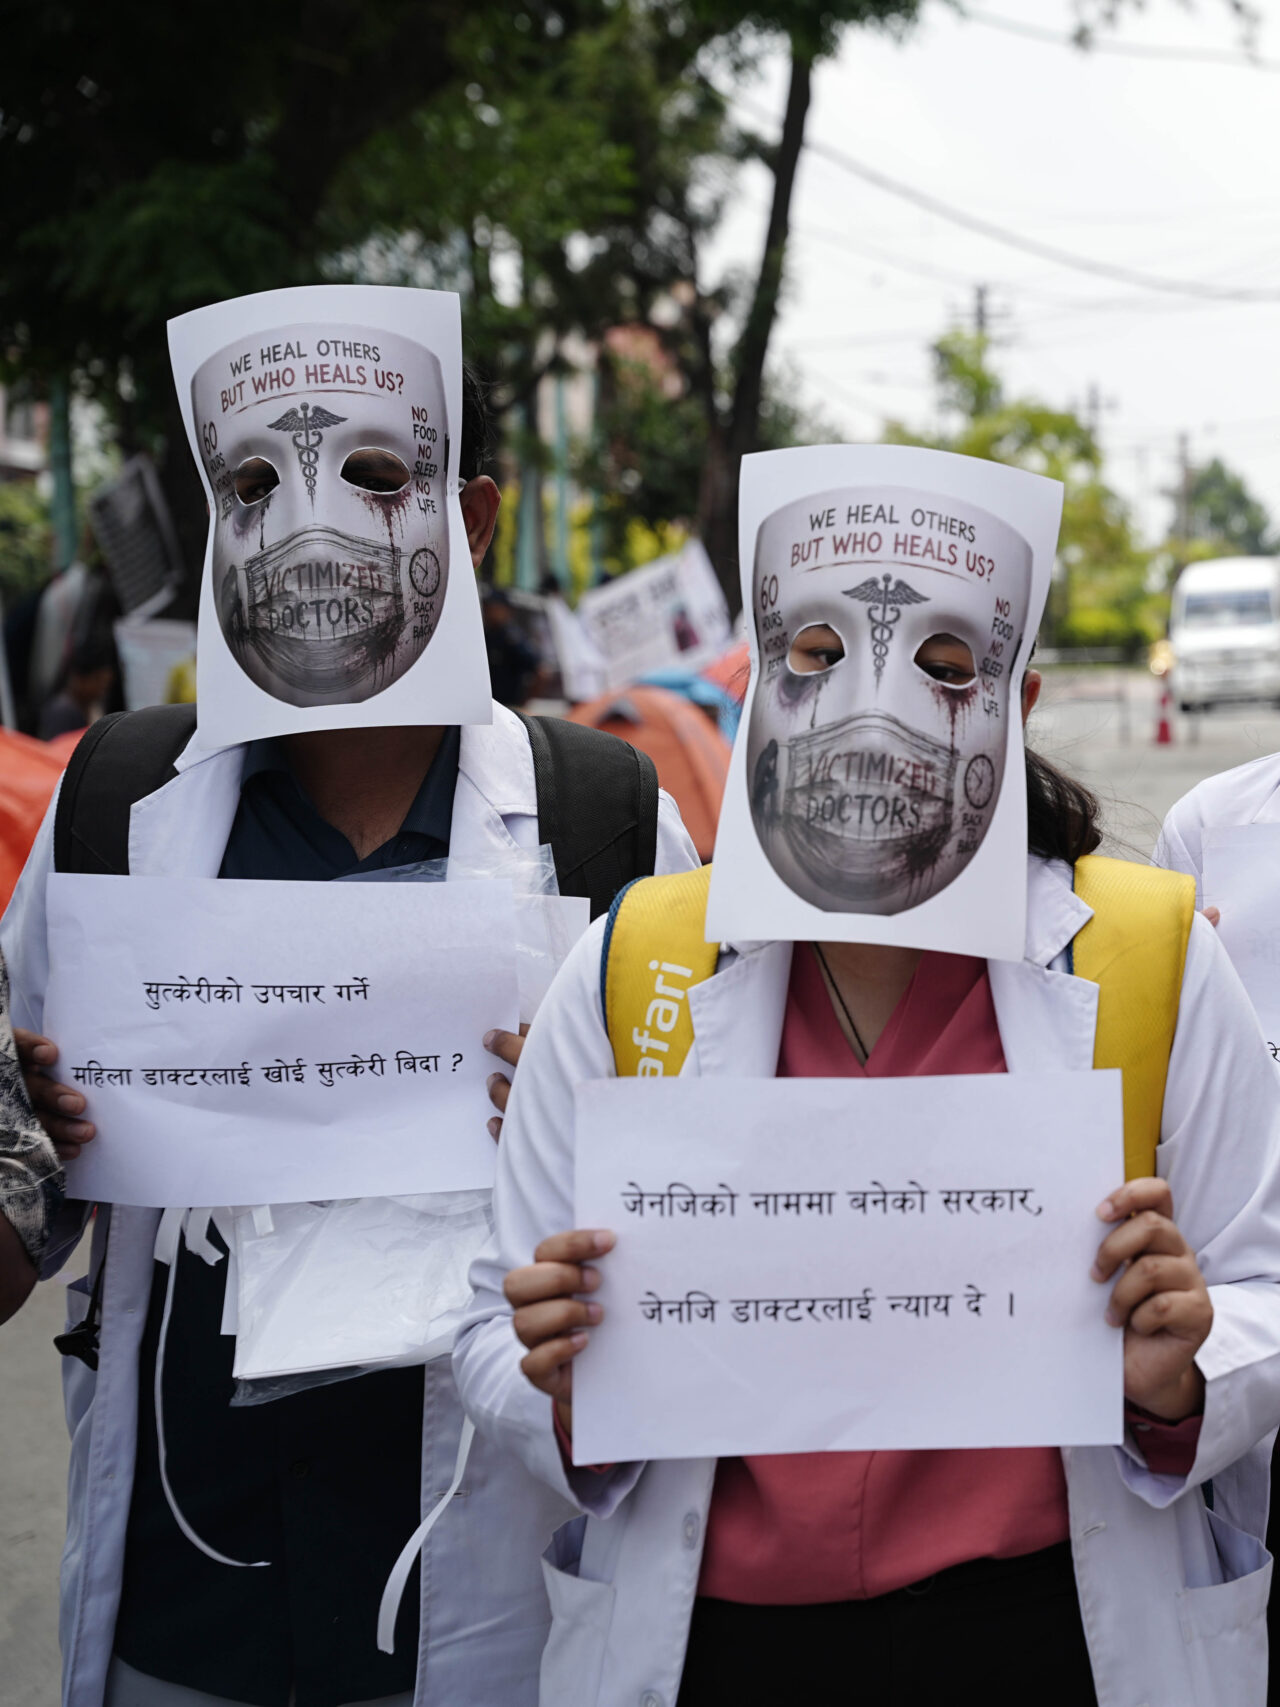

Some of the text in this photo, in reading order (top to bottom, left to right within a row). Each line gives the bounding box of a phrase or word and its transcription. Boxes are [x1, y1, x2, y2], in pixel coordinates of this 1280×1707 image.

[230, 340, 381, 377] WE HEAL OTHERS
[220, 364, 404, 413] BUT WHO HEALS US?
[411, 406, 428, 423] NO
[203, 421, 218, 456] 60
[413, 424, 438, 443] FOOD
[418, 444, 432, 460] NO
[413, 460, 438, 478] SLEEP
[416, 480, 431, 496] NO
[417, 497, 437, 514] LIFE
[809, 504, 976, 543] WE HEAL OTHERS
[790, 531, 995, 583] BUT WHO HEALS US?
[760, 575, 778, 611] 60
[996, 597, 1011, 617] NO
[268, 597, 374, 633] DOCTORS
[413, 601, 435, 615] BACK
[420, 614, 429, 625] TO
[991, 617, 1014, 641] FOOD
[989, 639, 1004, 657] NO
[981, 678, 995, 696] NO
[806, 794, 921, 829] DOCTORS
[142, 975, 370, 1010] सुत्केरीको उपचार गर्ने
[71, 1050, 463, 1088] महिला डाक्टरलाई खोई सुत्केरी बिदा ?
[623, 1181, 1042, 1216] जेनजिको नाममा बनेको सरकार,
[640, 1291, 718, 1323] जेनजि
[731, 1288, 875, 1323] डाक्टरलाई
[887, 1295, 952, 1317] न्याय
[965, 1284, 985, 1315] दे
